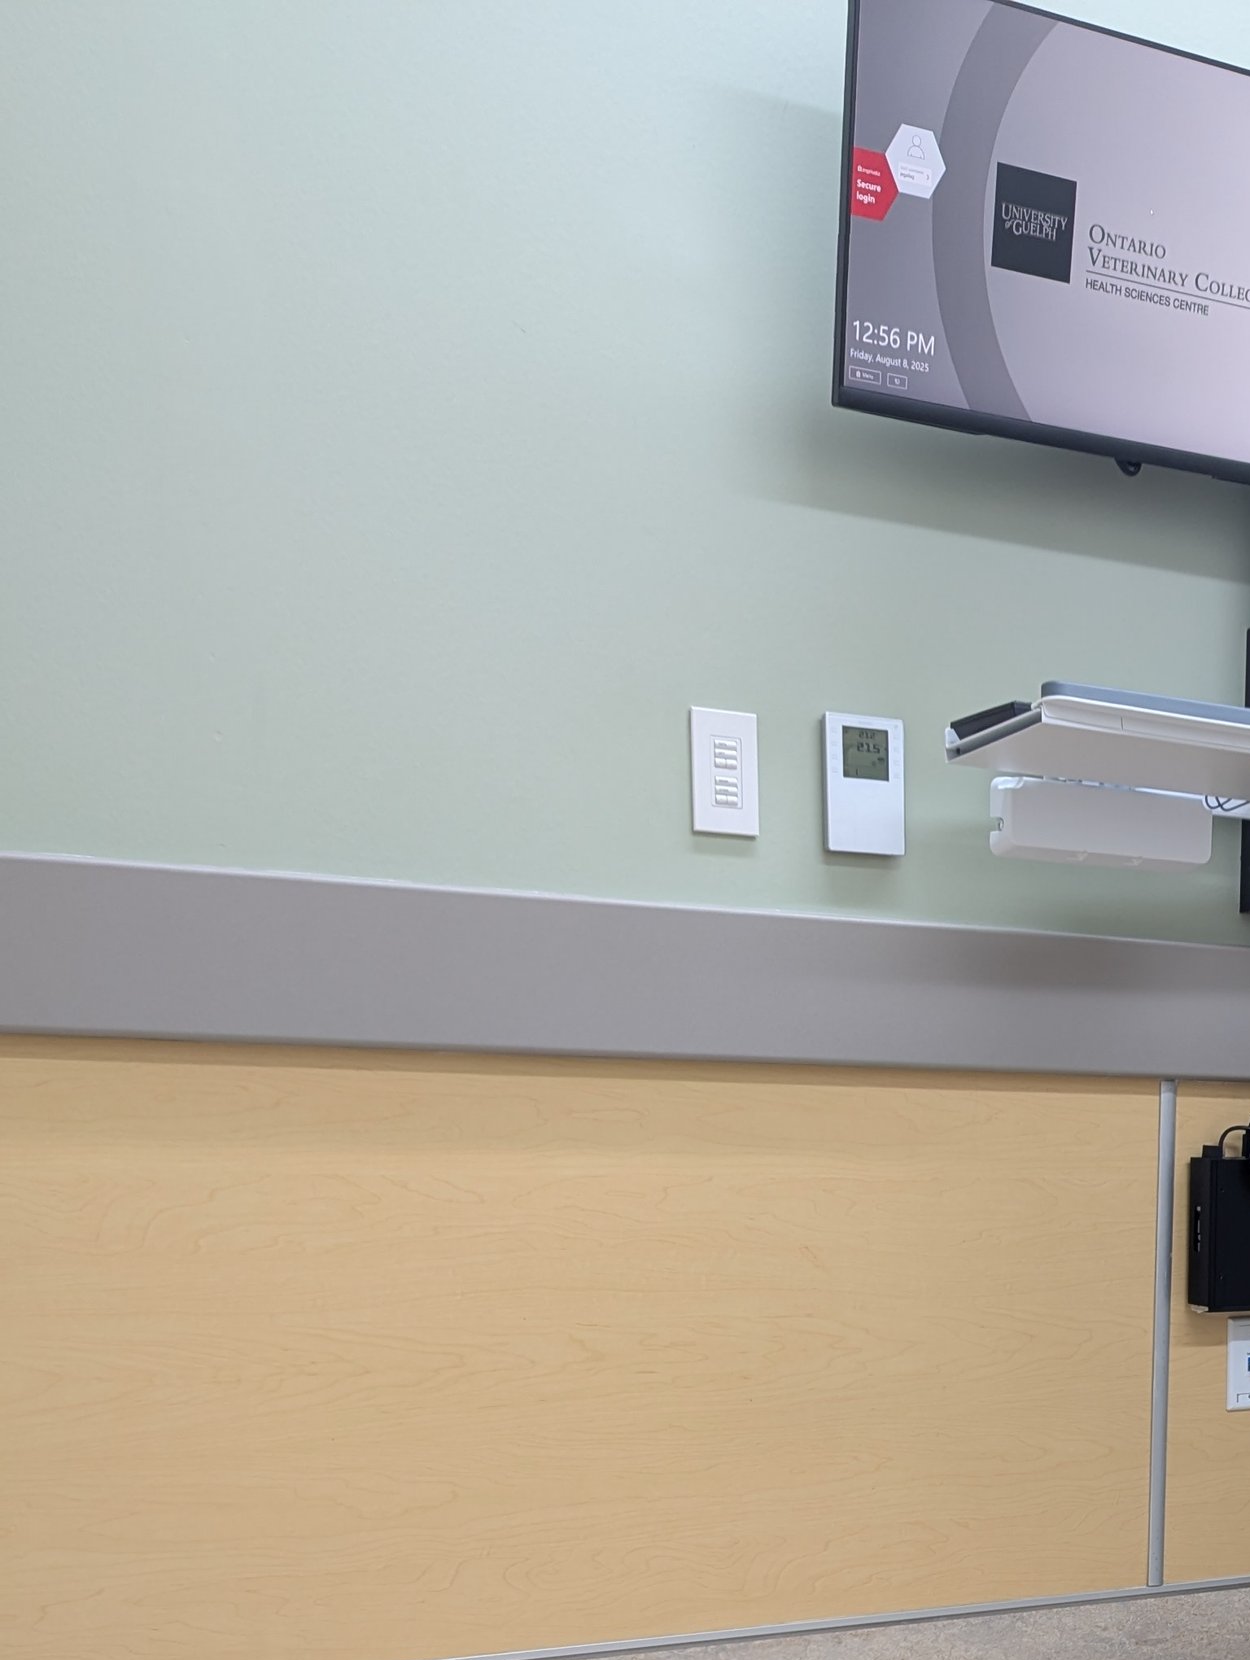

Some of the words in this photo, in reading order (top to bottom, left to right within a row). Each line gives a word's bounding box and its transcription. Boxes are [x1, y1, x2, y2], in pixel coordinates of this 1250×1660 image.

[856, 191, 875, 204] login
[857, 179, 881, 192] Secure
[1002, 202, 1068, 231] UNIVERSITY
[1004, 219, 1014, 229] of
[1012, 219, 1056, 241] GUELPH
[1089, 224, 1166, 259] ONTARIO
[1088, 246, 1188, 287] VETERINARY
[1085, 278, 1122, 296] HEALTH
[1124, 287, 1171, 307] SCIENCES
[1173, 298, 1209, 316] CENTRE
[853, 320, 900, 349] 12:56
[907, 330, 935, 356] PM
[850, 348, 874, 363] Friday,
[875, 354, 901, 367] August
[902, 358, 909, 370] 8,
[911, 361, 929, 372] 2025
